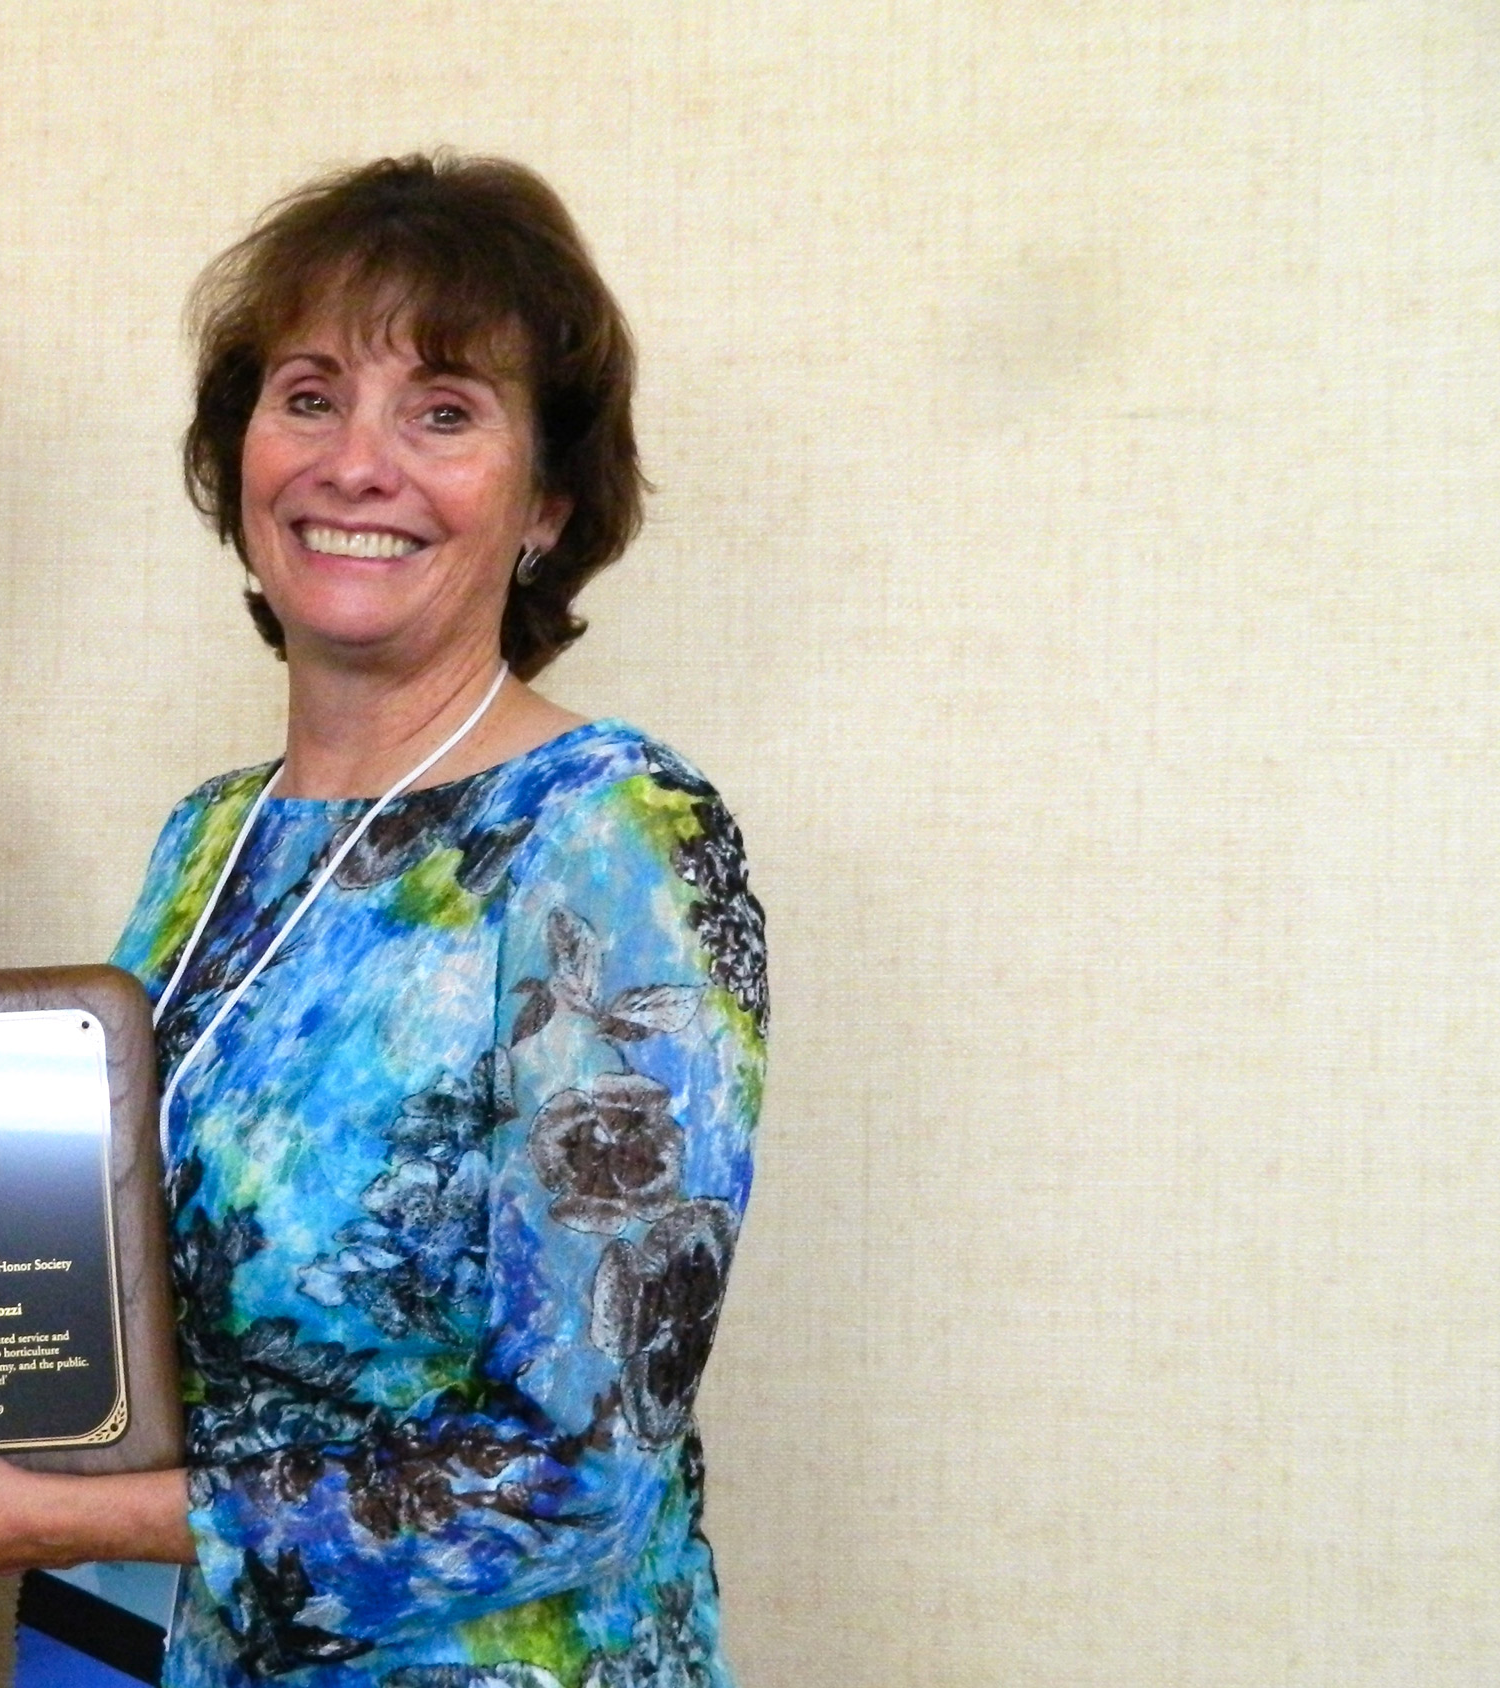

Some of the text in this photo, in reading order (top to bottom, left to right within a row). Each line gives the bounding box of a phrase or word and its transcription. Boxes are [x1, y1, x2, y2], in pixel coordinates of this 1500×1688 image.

[35, 1259, 72, 1271] Society
[18, 1334, 49, 1344] service
[52, 1331, 70, 1341] and
[4, 1347, 59, 1358] horticulture
[19, 1360, 37, 1371] and
[39, 1360, 54, 1369] the
[57, 1358, 89, 1370] public.
